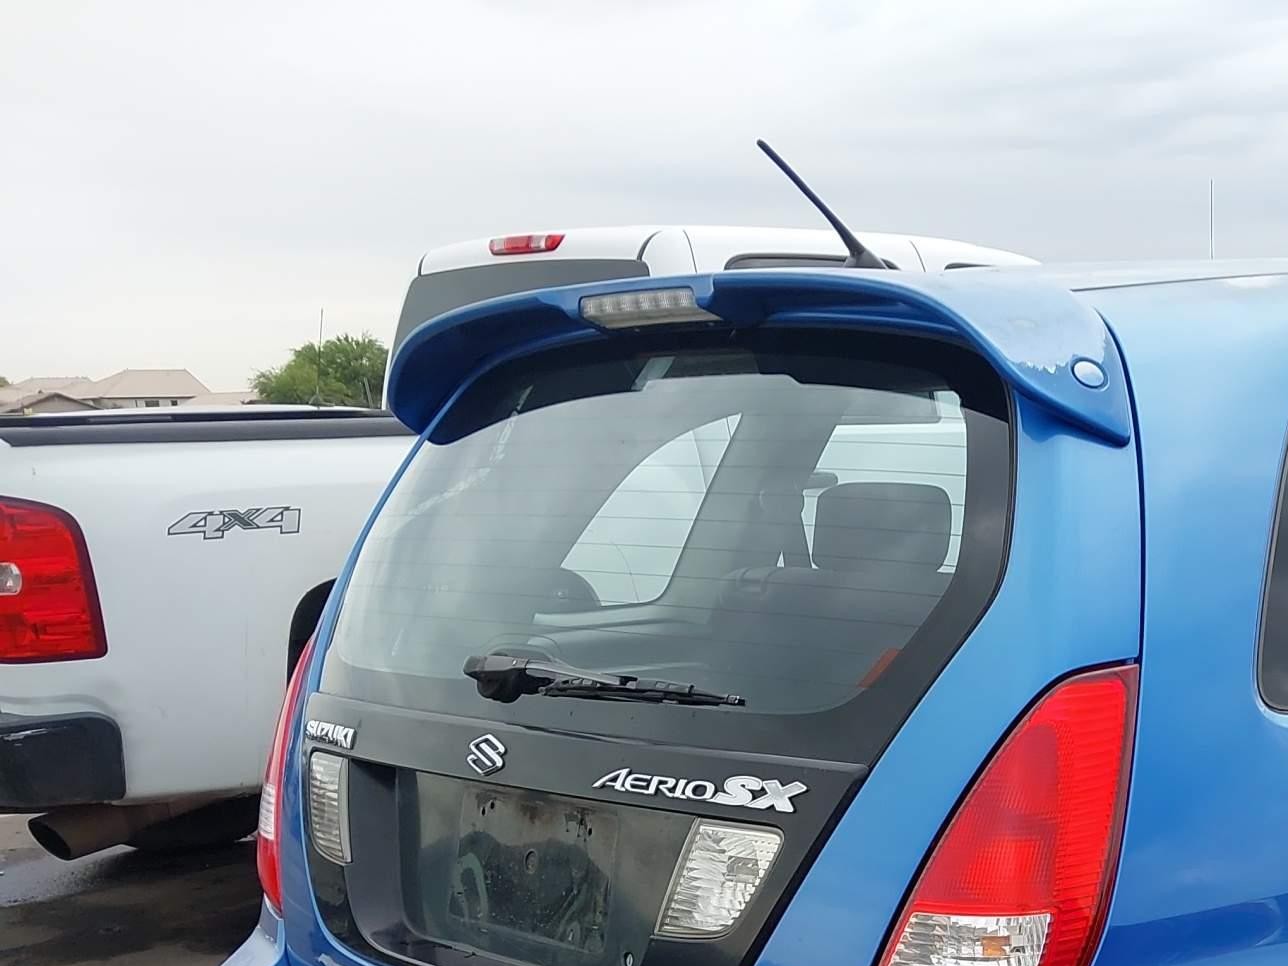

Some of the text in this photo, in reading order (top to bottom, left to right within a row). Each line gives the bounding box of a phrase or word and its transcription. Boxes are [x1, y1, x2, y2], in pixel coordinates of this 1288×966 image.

[306, 720, 355, 749] SUZUKI
[592, 767, 808, 813] AERIO SX
